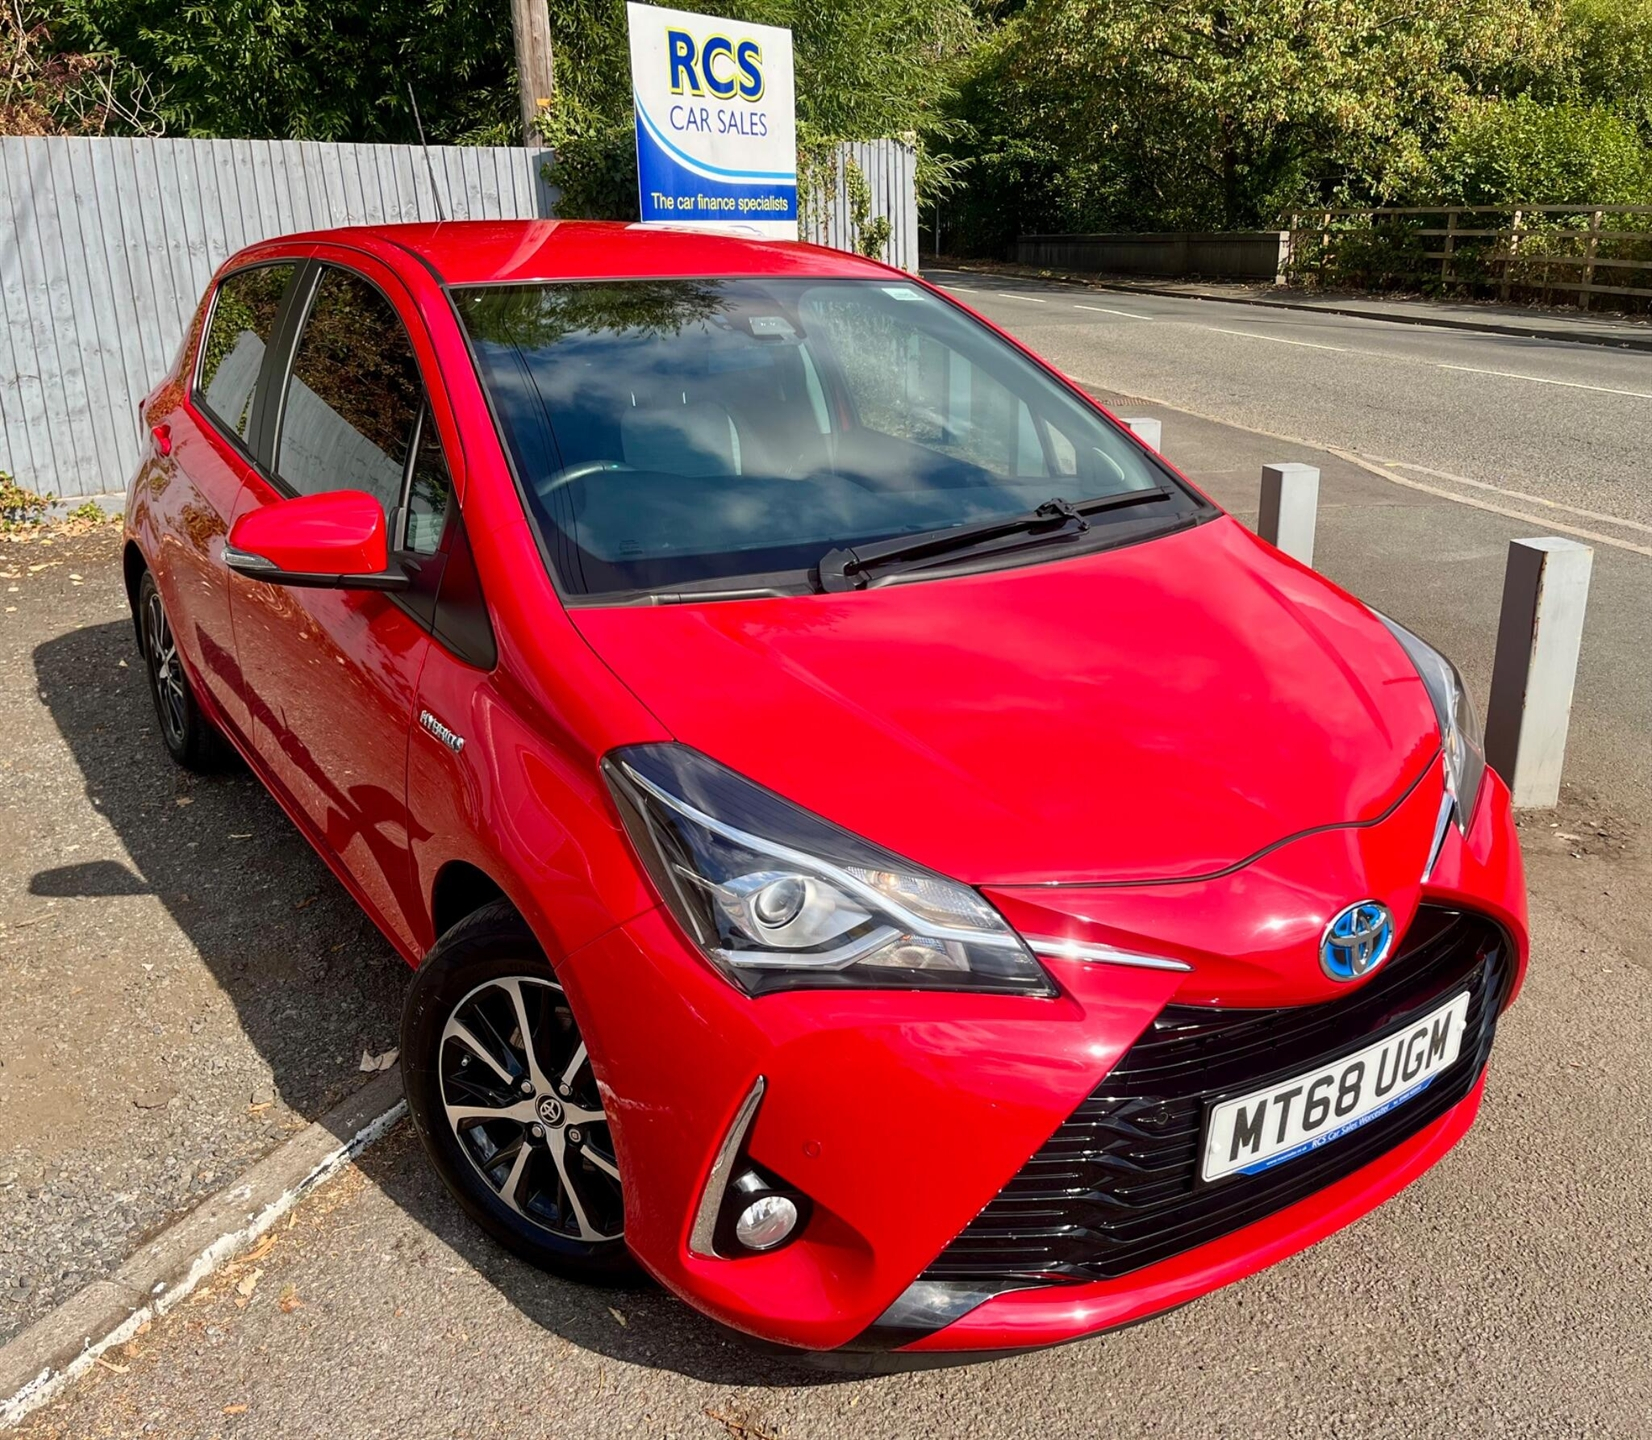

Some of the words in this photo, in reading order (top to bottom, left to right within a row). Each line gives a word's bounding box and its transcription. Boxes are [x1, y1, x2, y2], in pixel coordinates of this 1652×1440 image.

[666, 27, 765, 101] RCS
[669, 105, 712, 133] CAR
[718, 110, 768, 137] SALES
[651, 192, 675, 210] The
[677, 195, 694, 210] car
[697, 193, 735, 211] finance
[738, 195, 789, 217] specialists
[1229, 1060, 1366, 1162] MT68
[1374, 1010, 1454, 1098] UGM
[1311, 1135, 1328, 1150] RCS
[1328, 1130, 1341, 1142] Car
[1342, 1121, 1359, 1135] Sales
